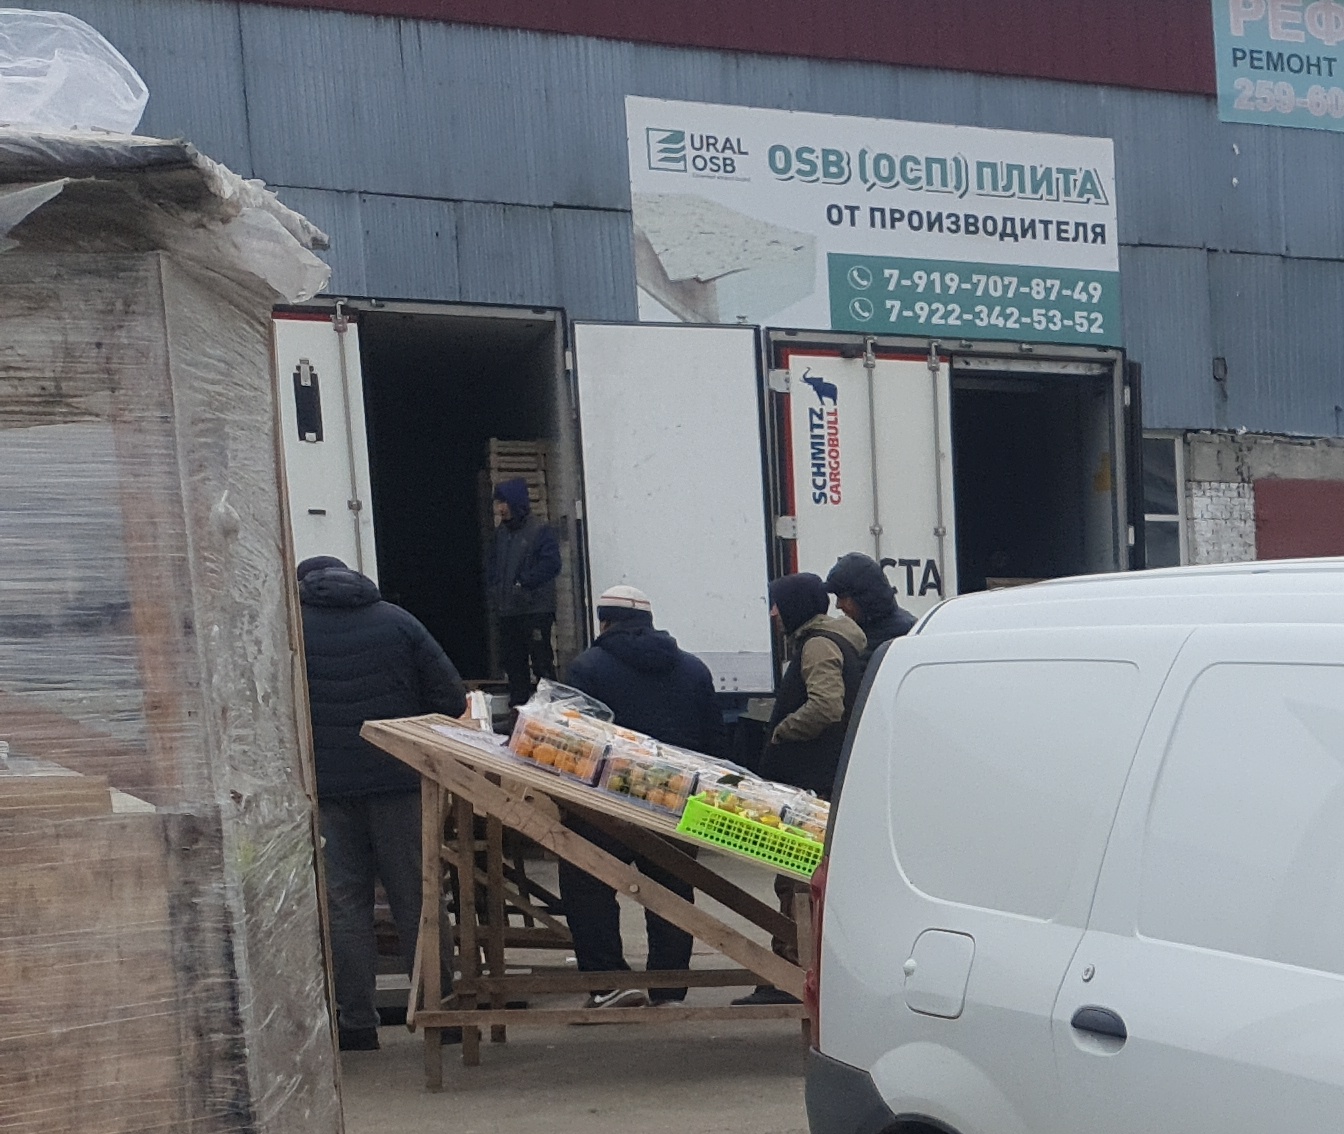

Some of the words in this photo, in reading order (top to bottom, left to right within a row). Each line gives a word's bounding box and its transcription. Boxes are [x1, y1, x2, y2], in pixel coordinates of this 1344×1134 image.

[1232, 47, 1337, 77] РЕМОНТ
[690, 133, 749, 155] URAL
[692, 154, 736, 173] OSB
[768, 144, 851, 185] OSB
[857, 147, 968, 199] (ОСП)
[975, 160, 1109, 206] ПЛИТА
[826, 203, 860, 227] ОТ
[869, 206, 1106, 245] ПРОИЗВОДИТЕЛЯ
[883, 268, 1102, 303] 7-919-707-87-49
[885, 299, 1104, 334] 7-922-342-53-52
[808, 407, 828, 505] SCHMITZ
[826, 408, 842, 506] CARGOBULL
